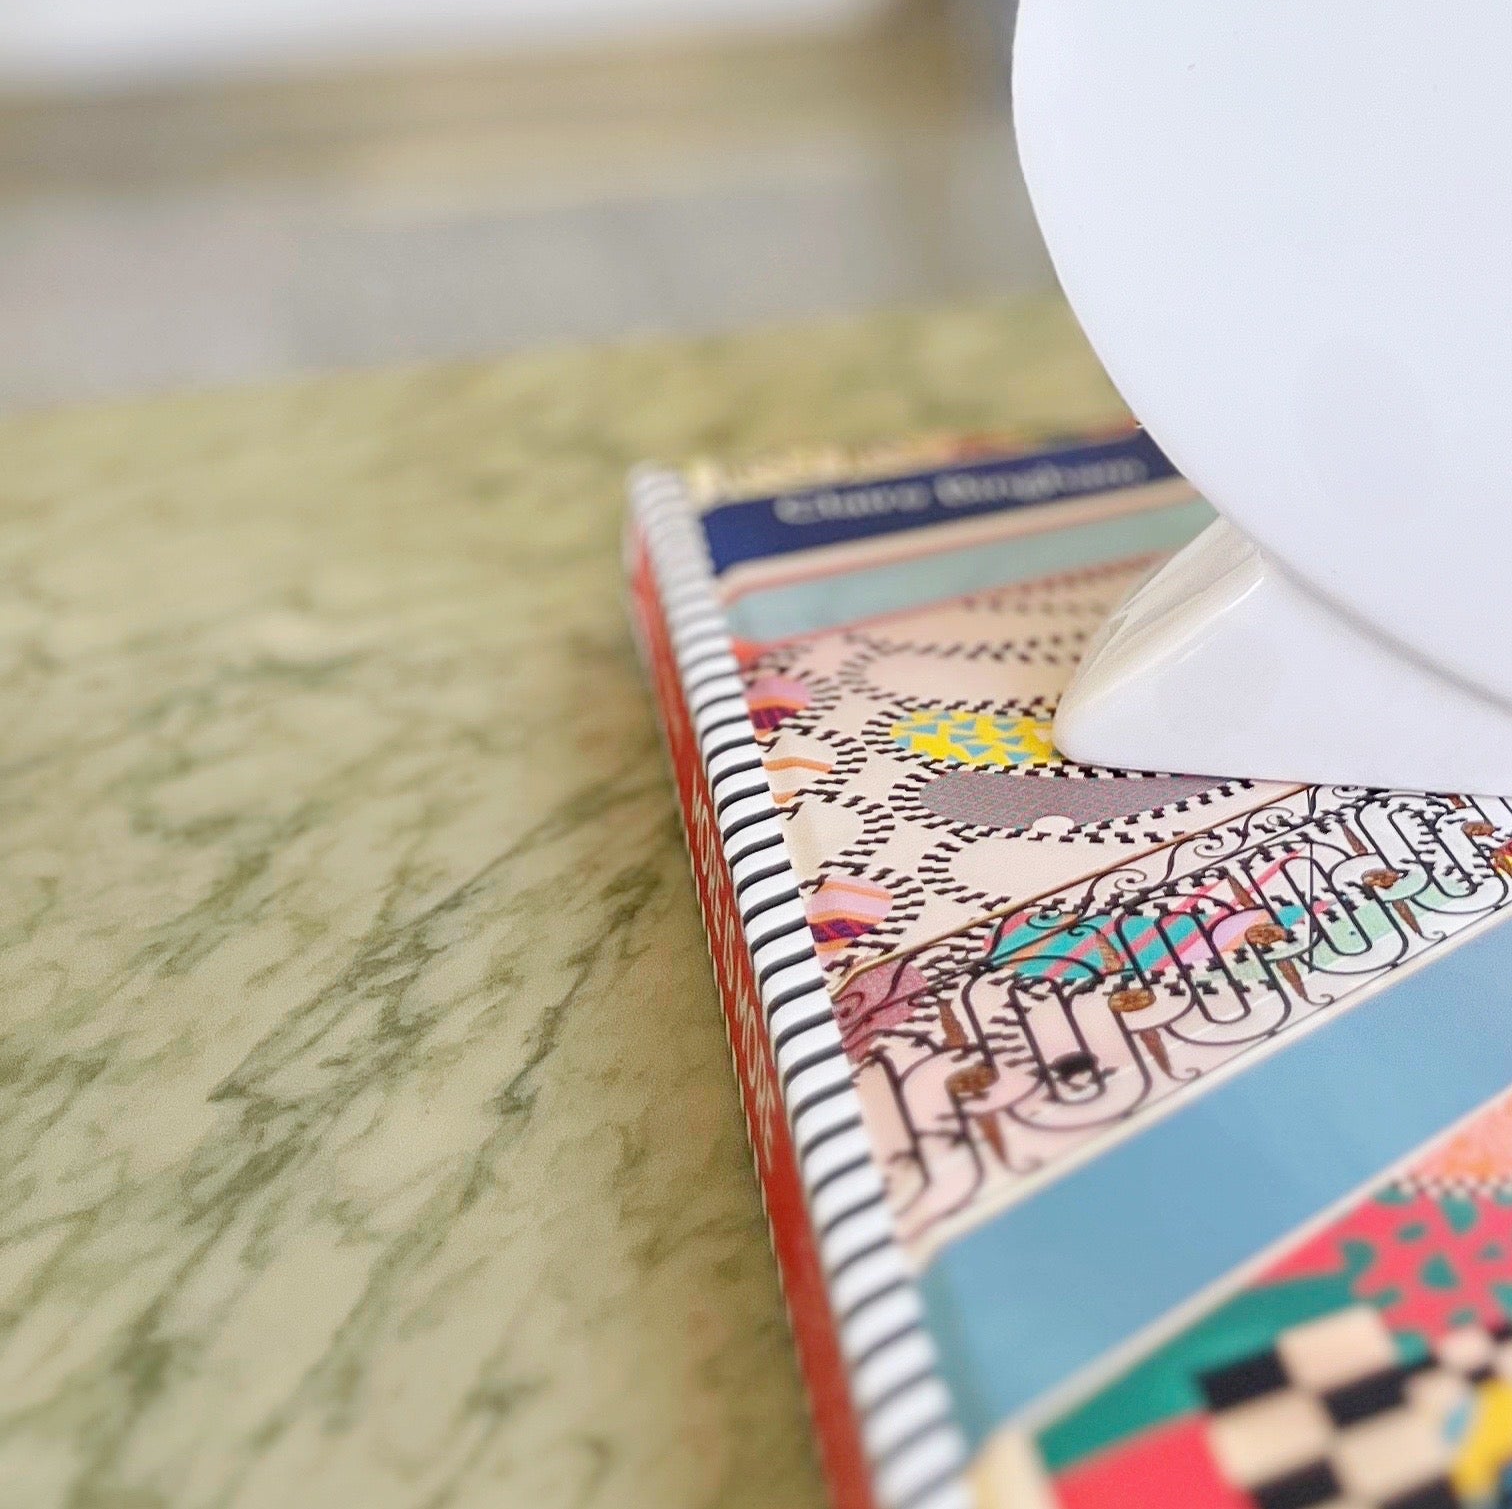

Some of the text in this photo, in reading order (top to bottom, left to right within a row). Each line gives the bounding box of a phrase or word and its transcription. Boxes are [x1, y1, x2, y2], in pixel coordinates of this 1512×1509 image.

[690, 763, 776, 1174] MORE IS MORE
